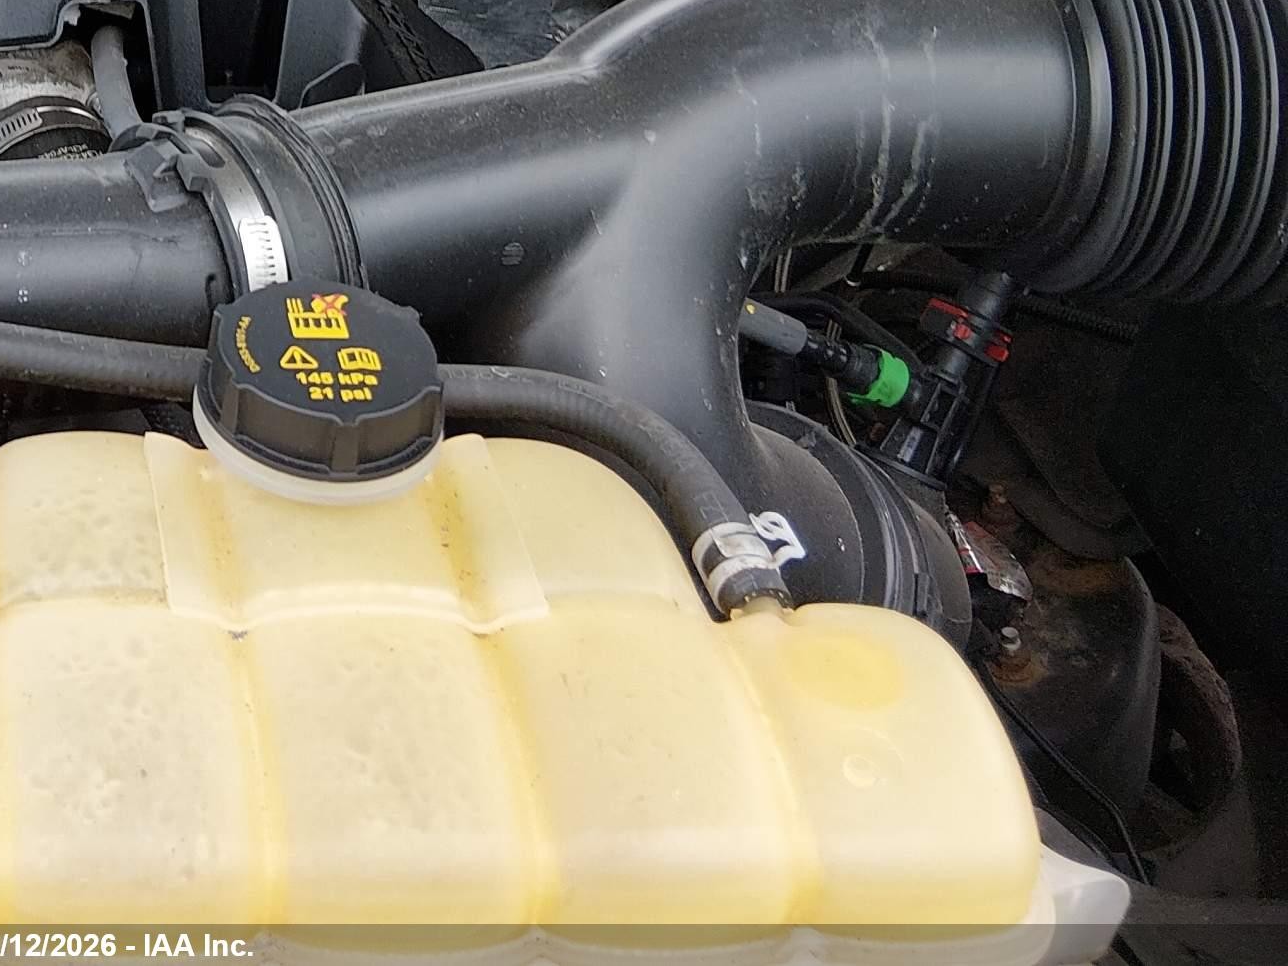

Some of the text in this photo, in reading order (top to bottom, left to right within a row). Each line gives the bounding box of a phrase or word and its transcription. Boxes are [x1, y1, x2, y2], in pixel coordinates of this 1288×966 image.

[295, 371, 379, 386] 145 kPa
[308, 386, 373, 403] 21 psi
